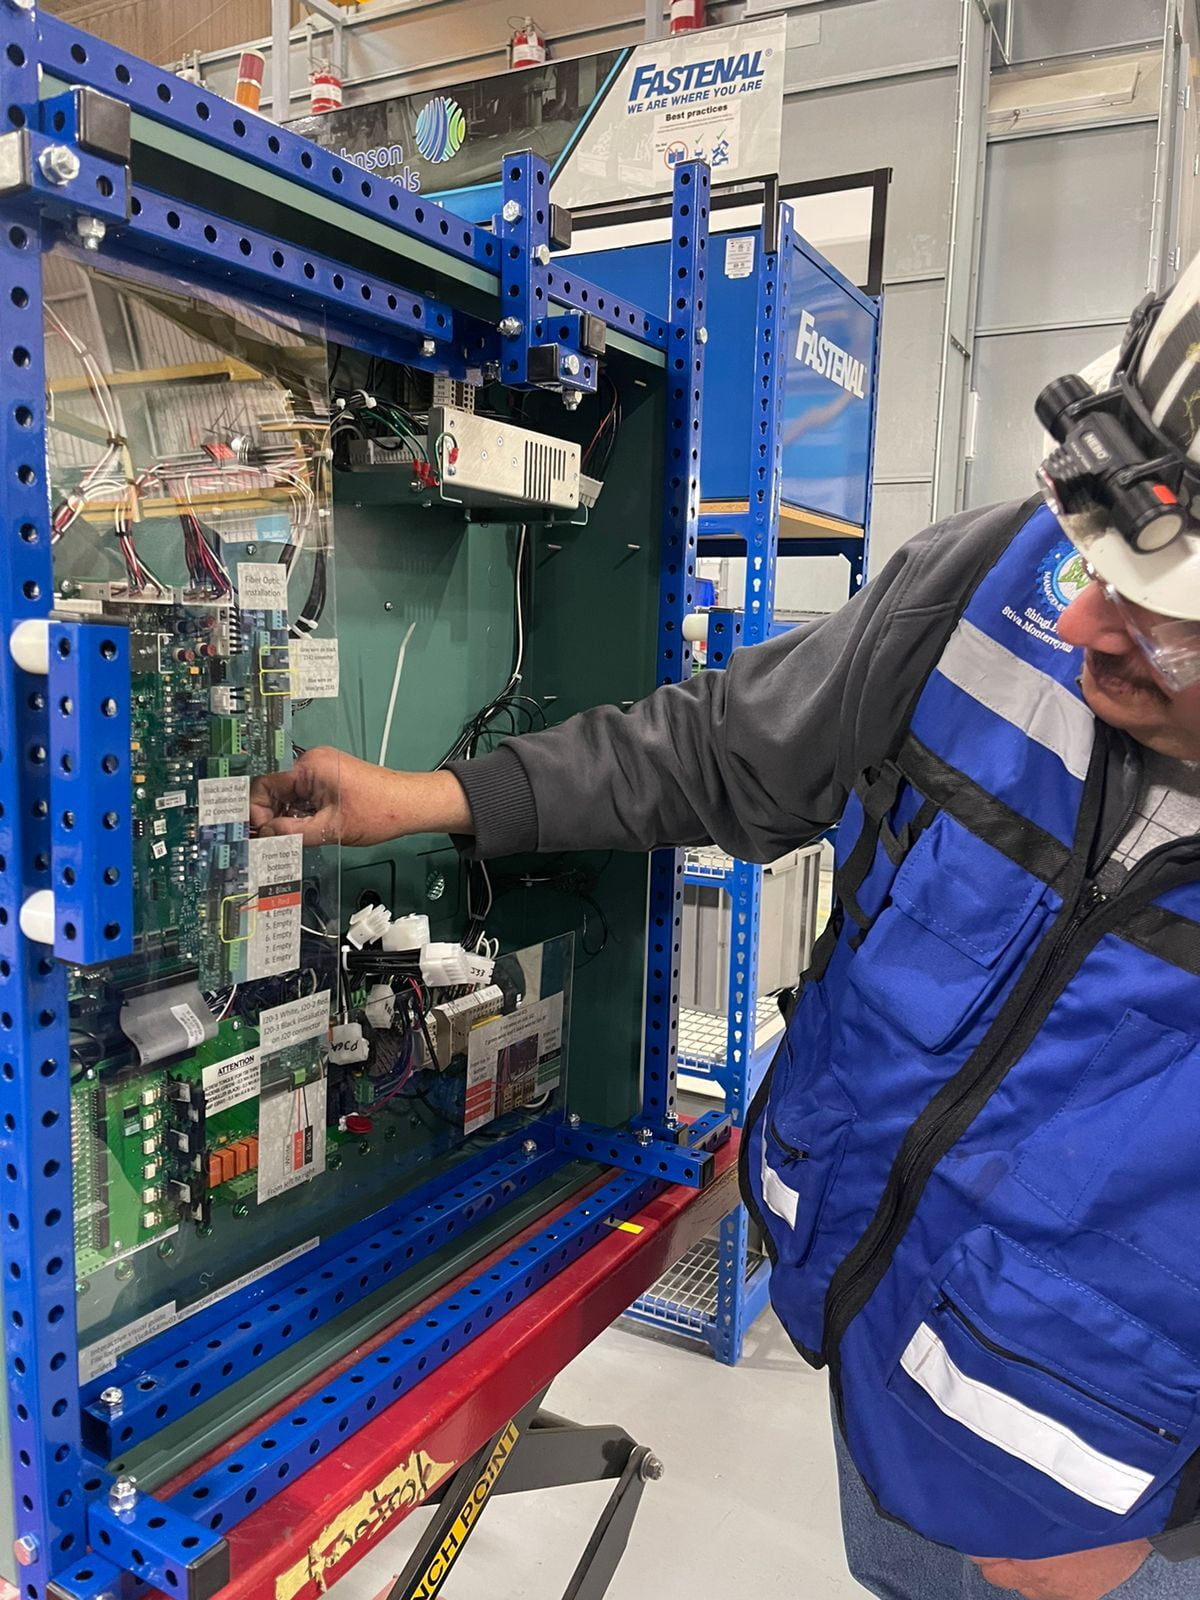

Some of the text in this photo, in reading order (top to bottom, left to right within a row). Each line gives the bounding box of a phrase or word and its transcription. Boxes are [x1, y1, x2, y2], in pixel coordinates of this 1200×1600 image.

[628, 50, 765, 102] FASTENAL
[628, 79, 763, 115] WE ARE WHERE YOU ARE
[665, 104, 728, 122] Best practices
[340, 144, 404, 171] hnson
[795, 309, 865, 400] FASTENAL
[245, 575, 280, 586] Fiber Optic
[1002, 606, 1022, 627] Stiva
[220, 784, 232, 793] and
[234, 784, 246, 792] Red
[262, 849, 299, 861] From top to
[273, 873, 293, 883] Empty
[275, 885, 292, 894] Black
[273, 908, 293, 918] Empty
[272, 919, 293, 930] Empty
[272, 931, 293, 941] Empty
[272, 942, 292, 953] Empty
[272, 953, 292, 964] Empty
[281, 1018, 296, 1030] Black
[218, 1055, 255, 1076] ATTENTION
[267, 1184, 283, 1196] From
[459, 1424, 519, 1531] POINT
